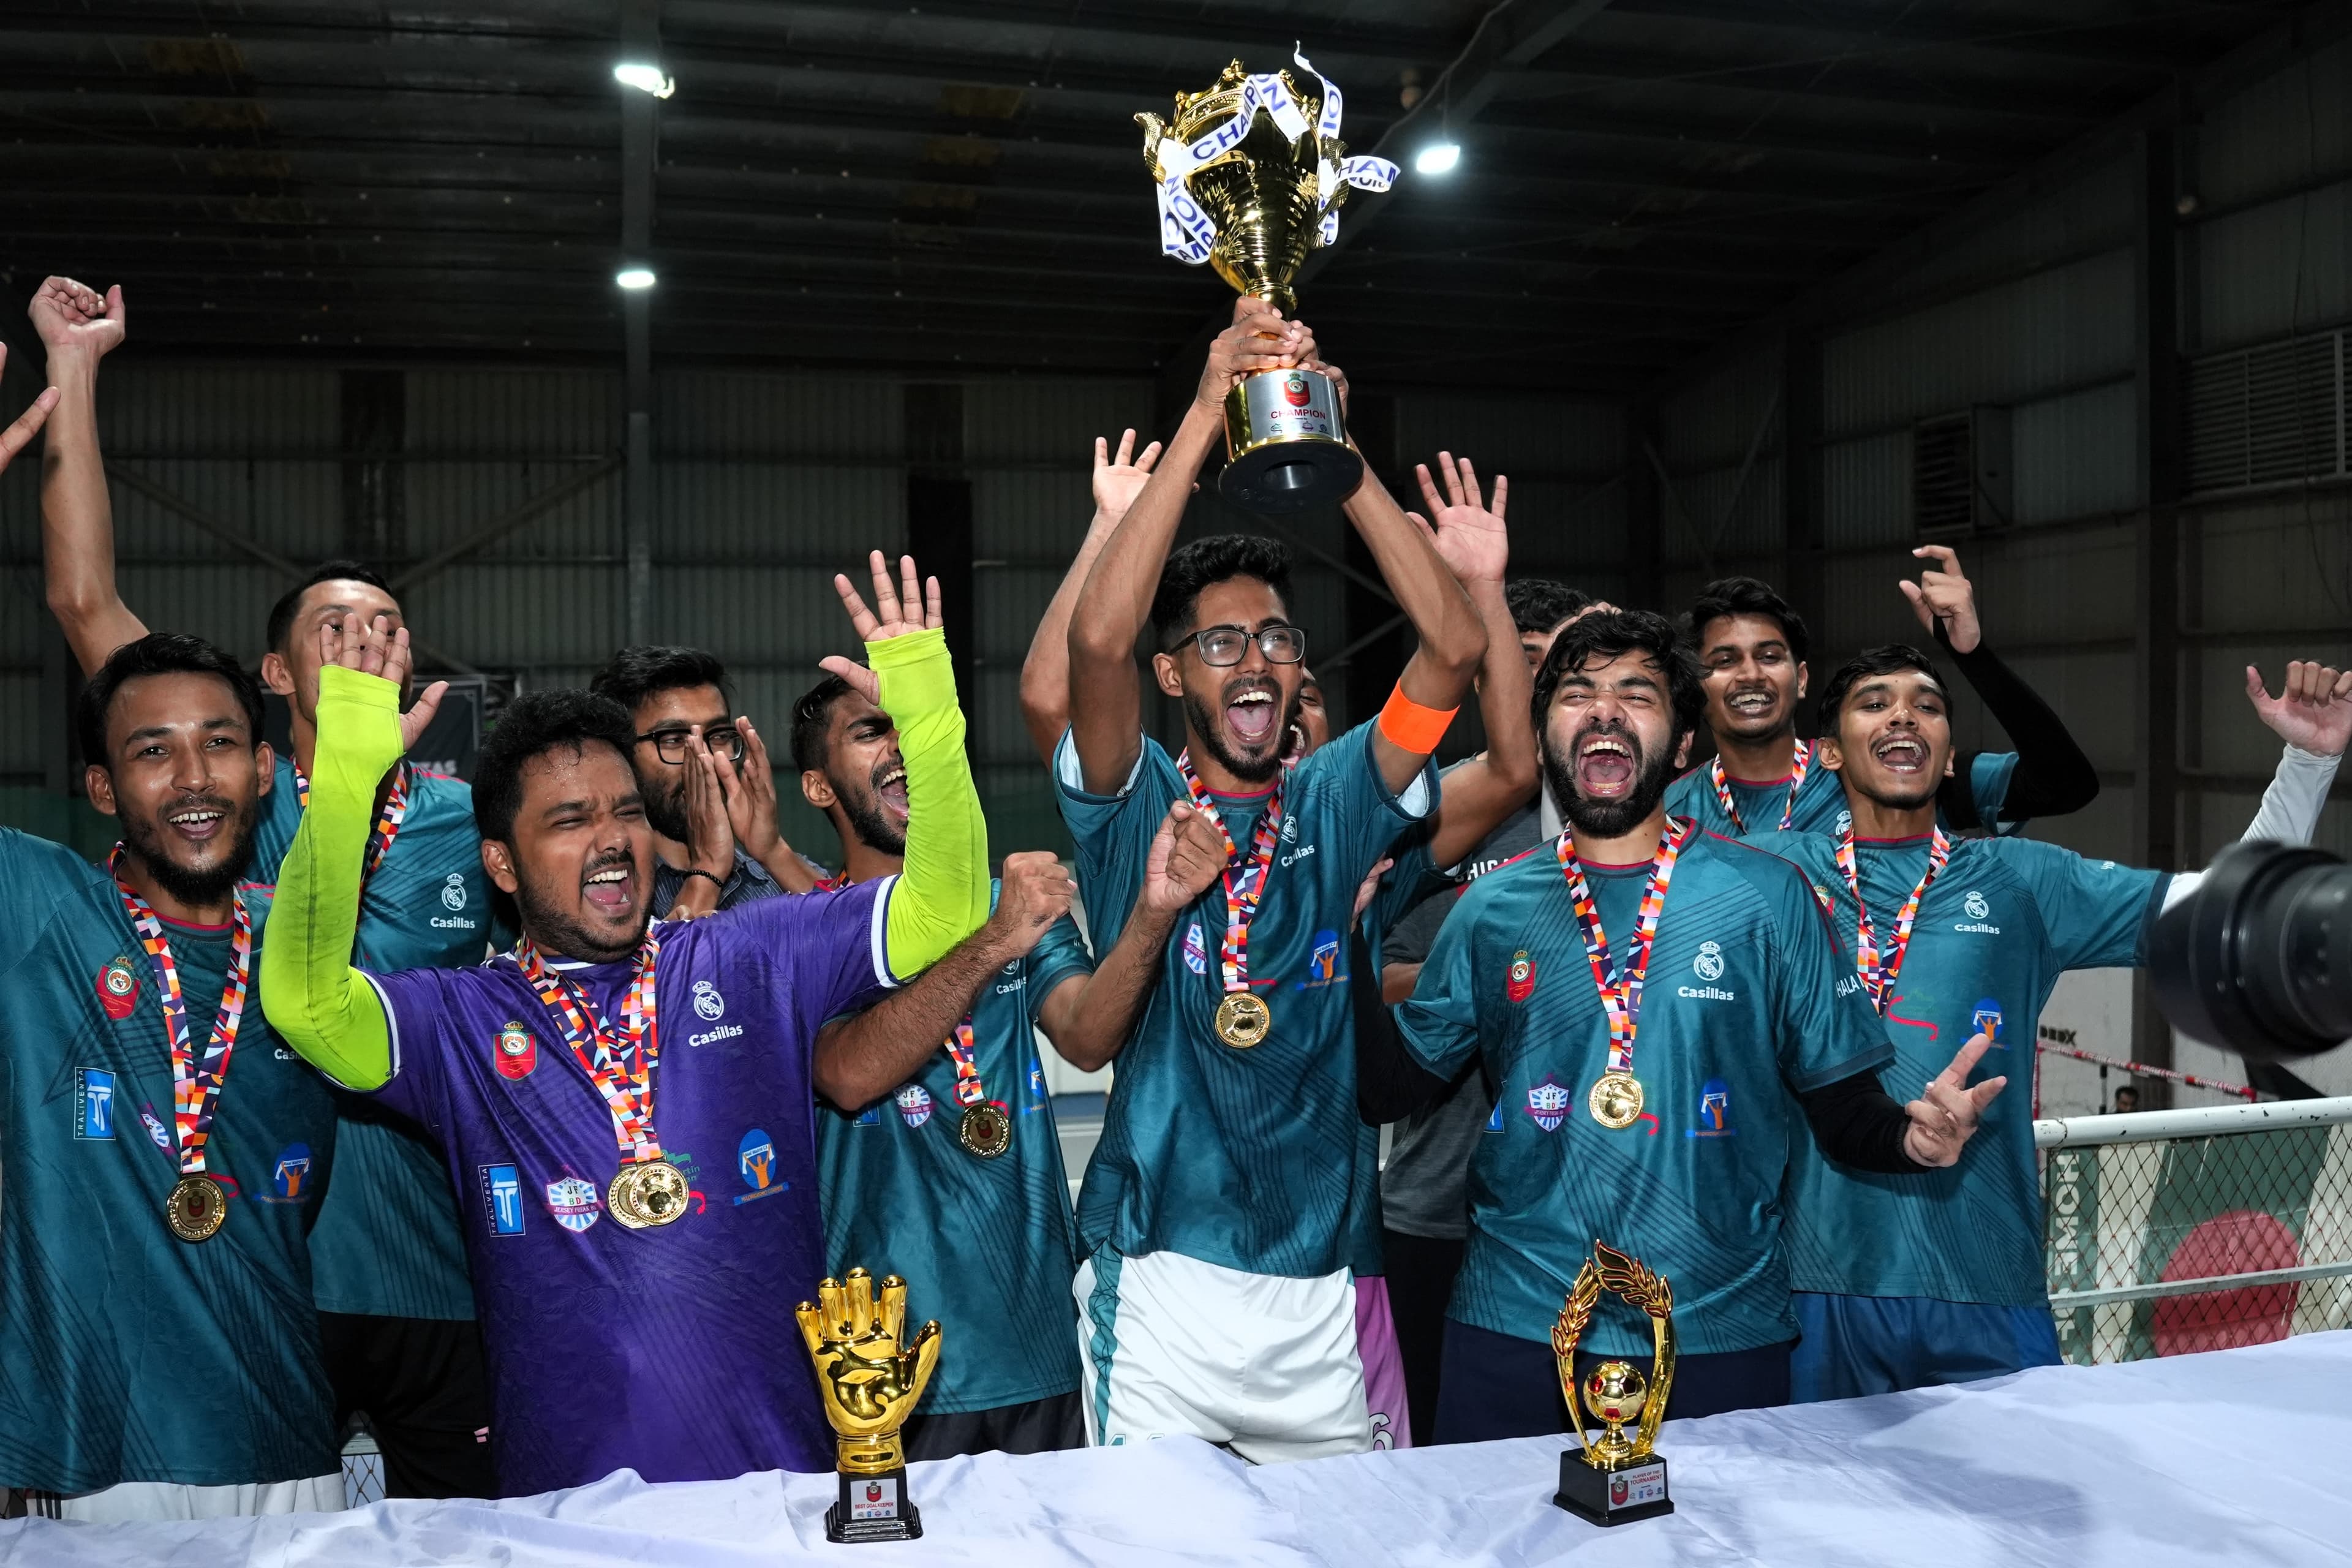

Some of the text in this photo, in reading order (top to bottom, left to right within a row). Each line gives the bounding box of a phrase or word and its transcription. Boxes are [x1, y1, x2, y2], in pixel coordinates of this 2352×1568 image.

[1270, 409, 1326, 420] CHAMPION
[430, 916, 475, 929] Casillas
[1954, 923, 2000, 935] Casillas
[1836, 975, 1860, 998] HALA
[1678, 986, 1734, 1001] Casillas
[688, 1025, 743, 1047] Casillas
[567, 1185, 578, 1194] JF
[482, 1168, 497, 1234] TRALIVENTA
[568, 1197, 581, 1205] BD
[1630, 1474, 1663, 1485] TOURNAMENT
